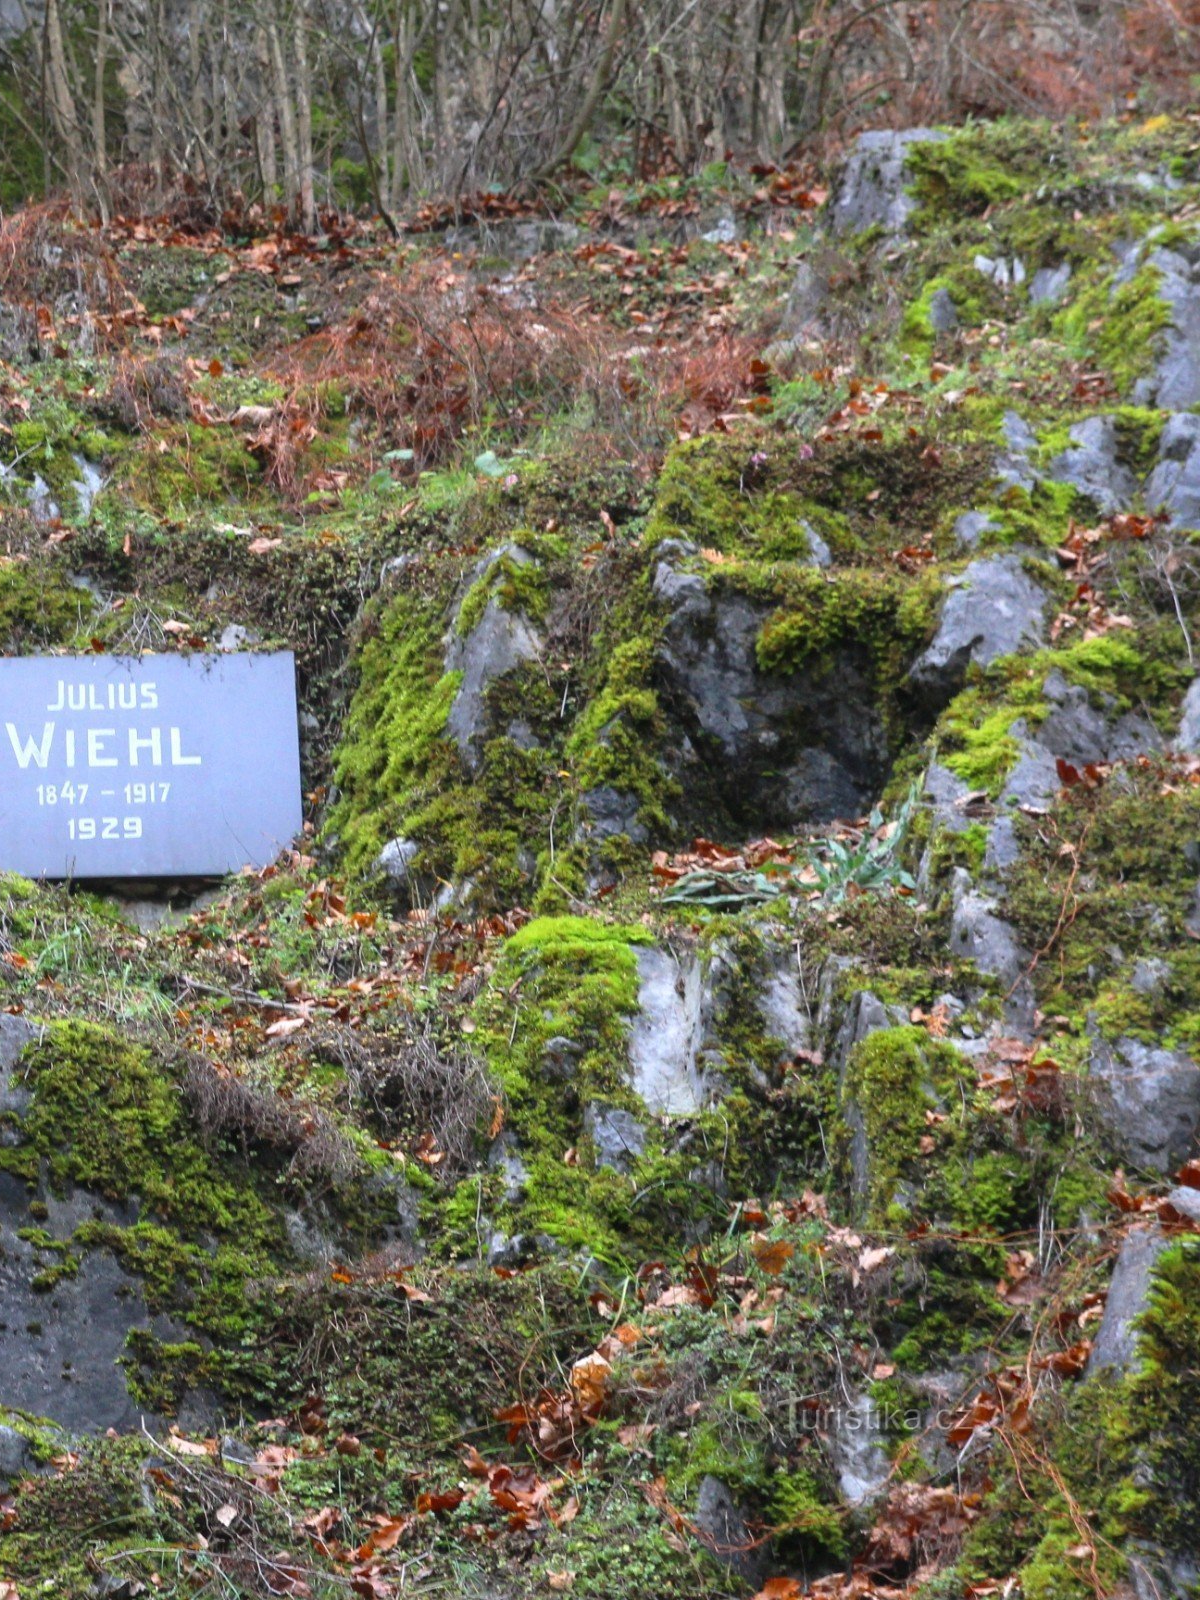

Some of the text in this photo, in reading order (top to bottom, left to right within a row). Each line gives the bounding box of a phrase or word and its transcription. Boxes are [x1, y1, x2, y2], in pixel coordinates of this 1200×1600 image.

[47, 681, 159, 711] JULIUS
[5, 722, 202, 768] WIEHL
[36, 780, 89, 806] 1847
[124, 782, 171, 804] 1917
[68, 816, 142, 840] 1929
